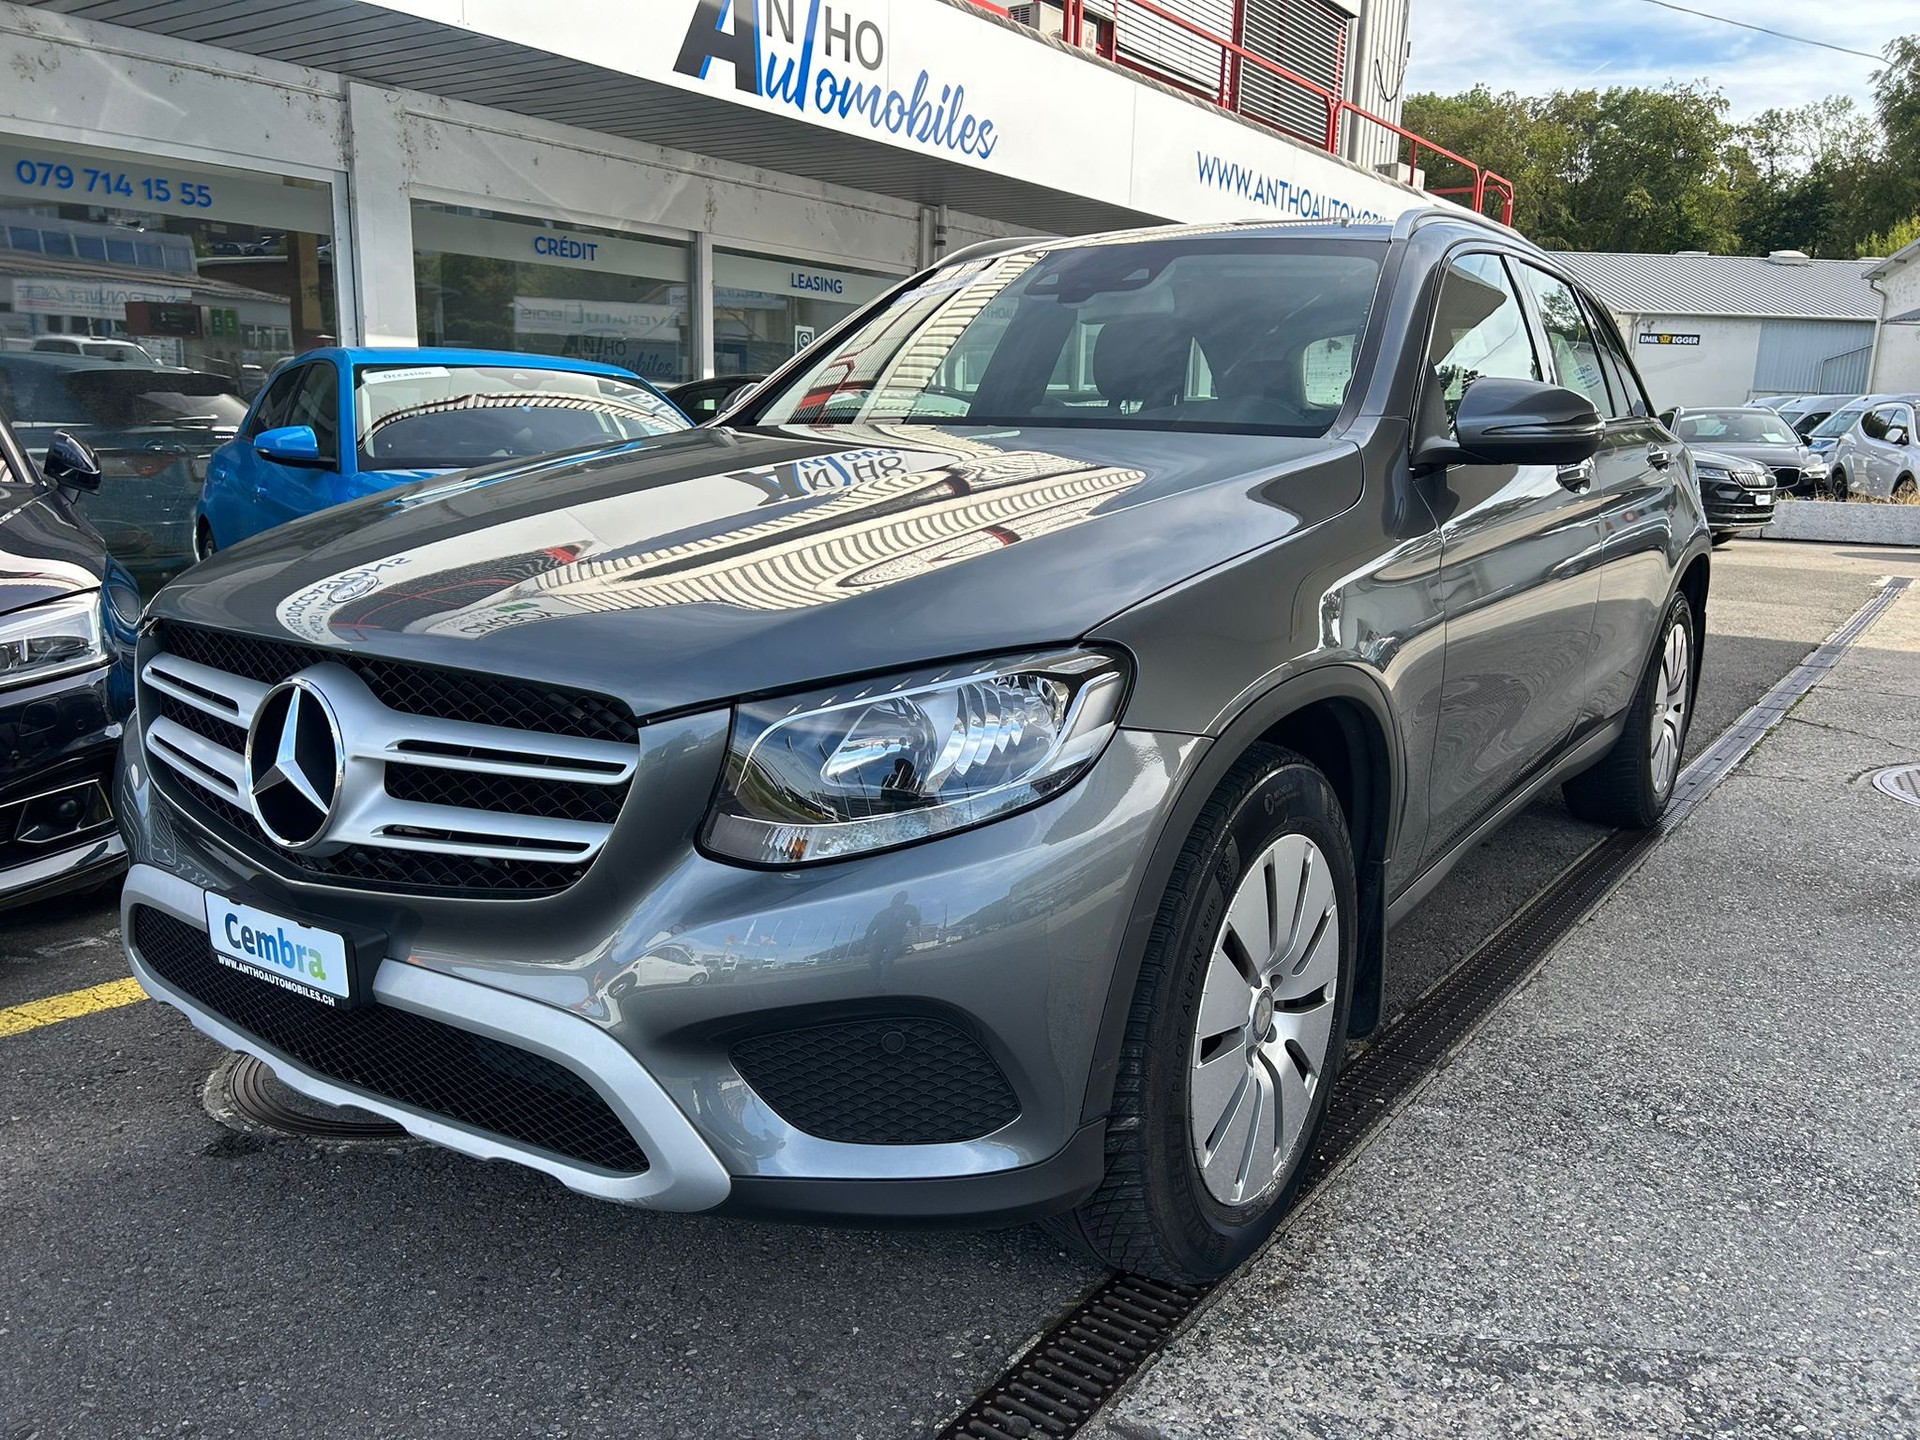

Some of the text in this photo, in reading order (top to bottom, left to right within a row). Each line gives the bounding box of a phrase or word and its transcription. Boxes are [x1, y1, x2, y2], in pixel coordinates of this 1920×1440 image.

[16, 160, 213, 208] 079 714 15 55
[534, 236, 598, 262] CRÉDIT
[791, 272, 843, 294] LEASING
[1640, 335, 1699, 345] EMIL EGGER
[224, 912, 327, 981] Cembra
[1182, 946, 1203, 1018] ALPIN
[1203, 899, 1217, 929] SUV
[217, 954, 336, 1007] WWW.ANTHOAUTOMOBILES.CH
